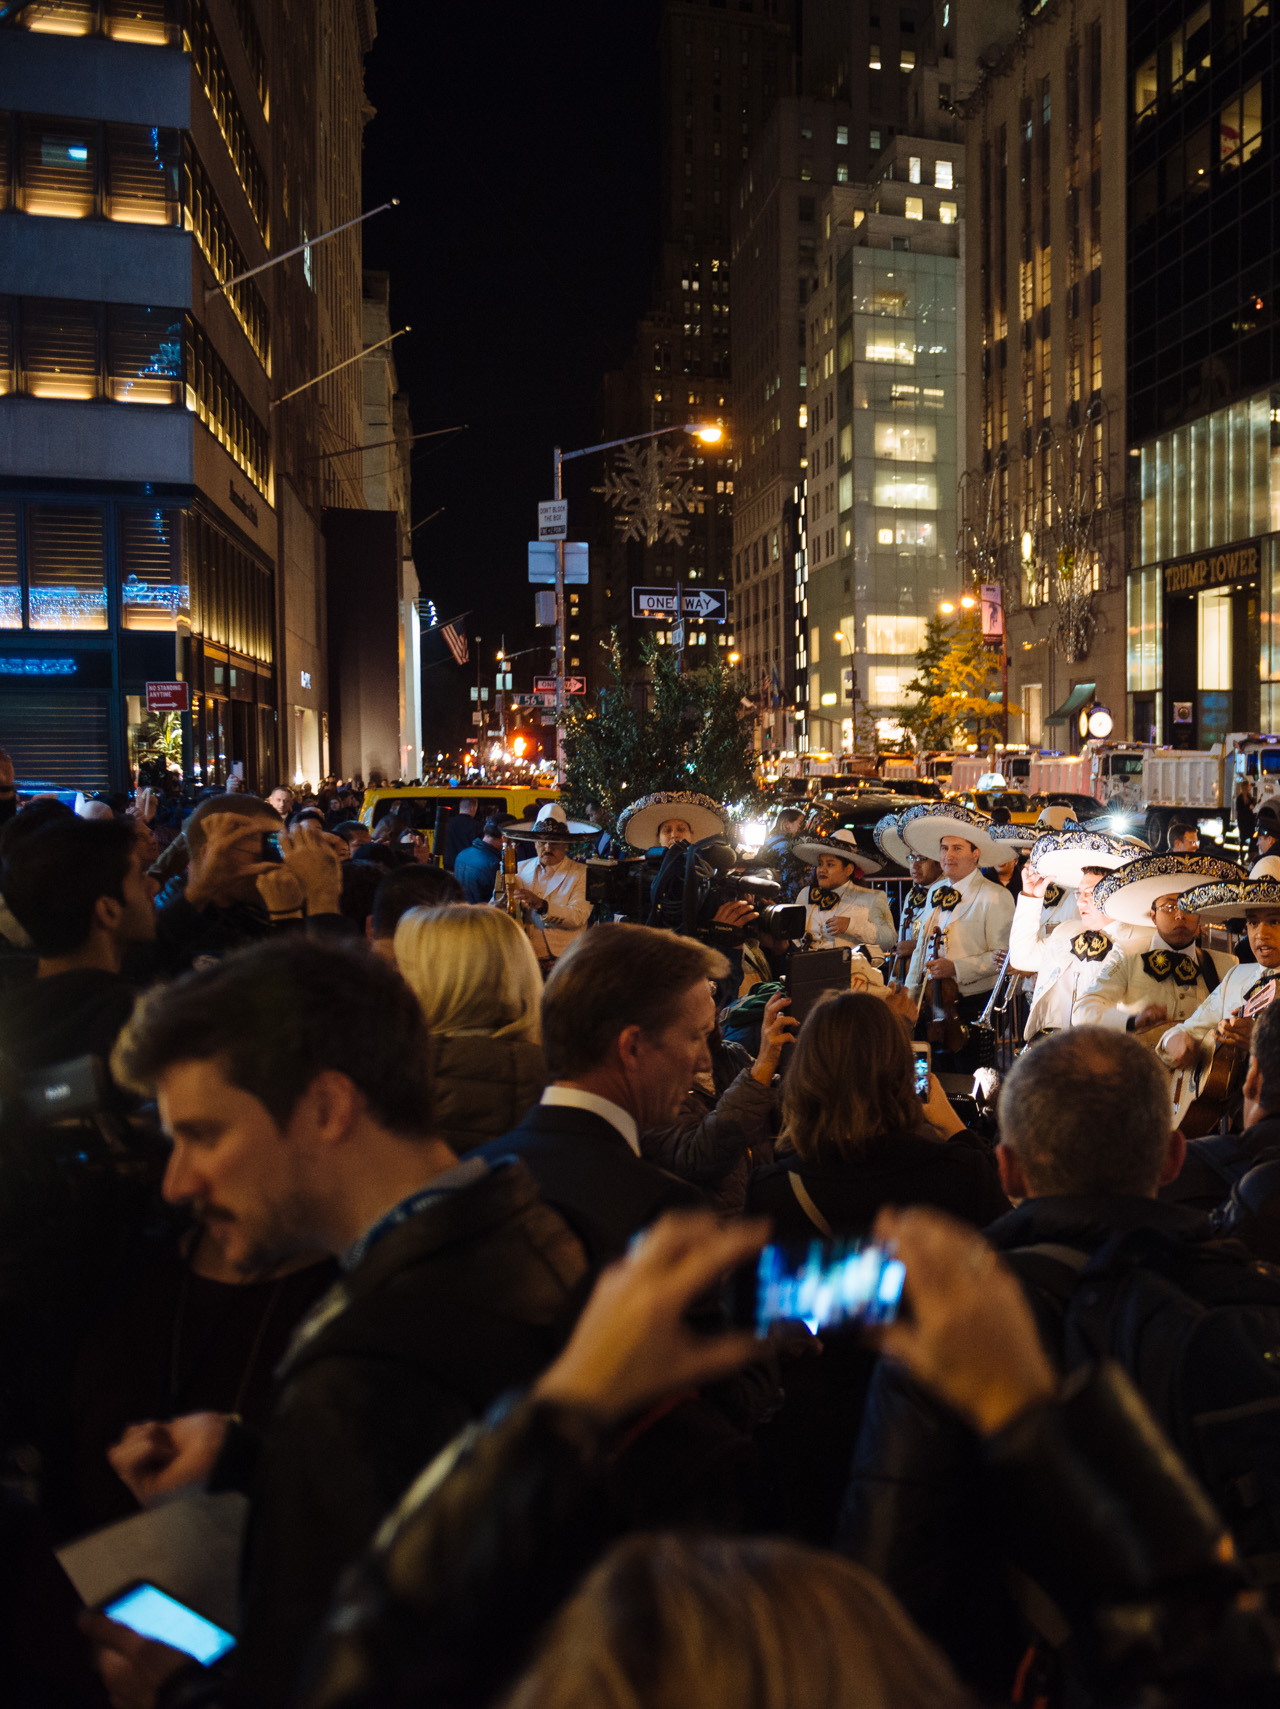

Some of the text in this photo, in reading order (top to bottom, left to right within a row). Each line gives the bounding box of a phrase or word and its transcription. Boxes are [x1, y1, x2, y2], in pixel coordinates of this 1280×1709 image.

[1165, 547, 1258, 593] TRUMP TOWER
[647, 597, 712, 610] ONE WAY
[524, 695, 537, 705] 56
